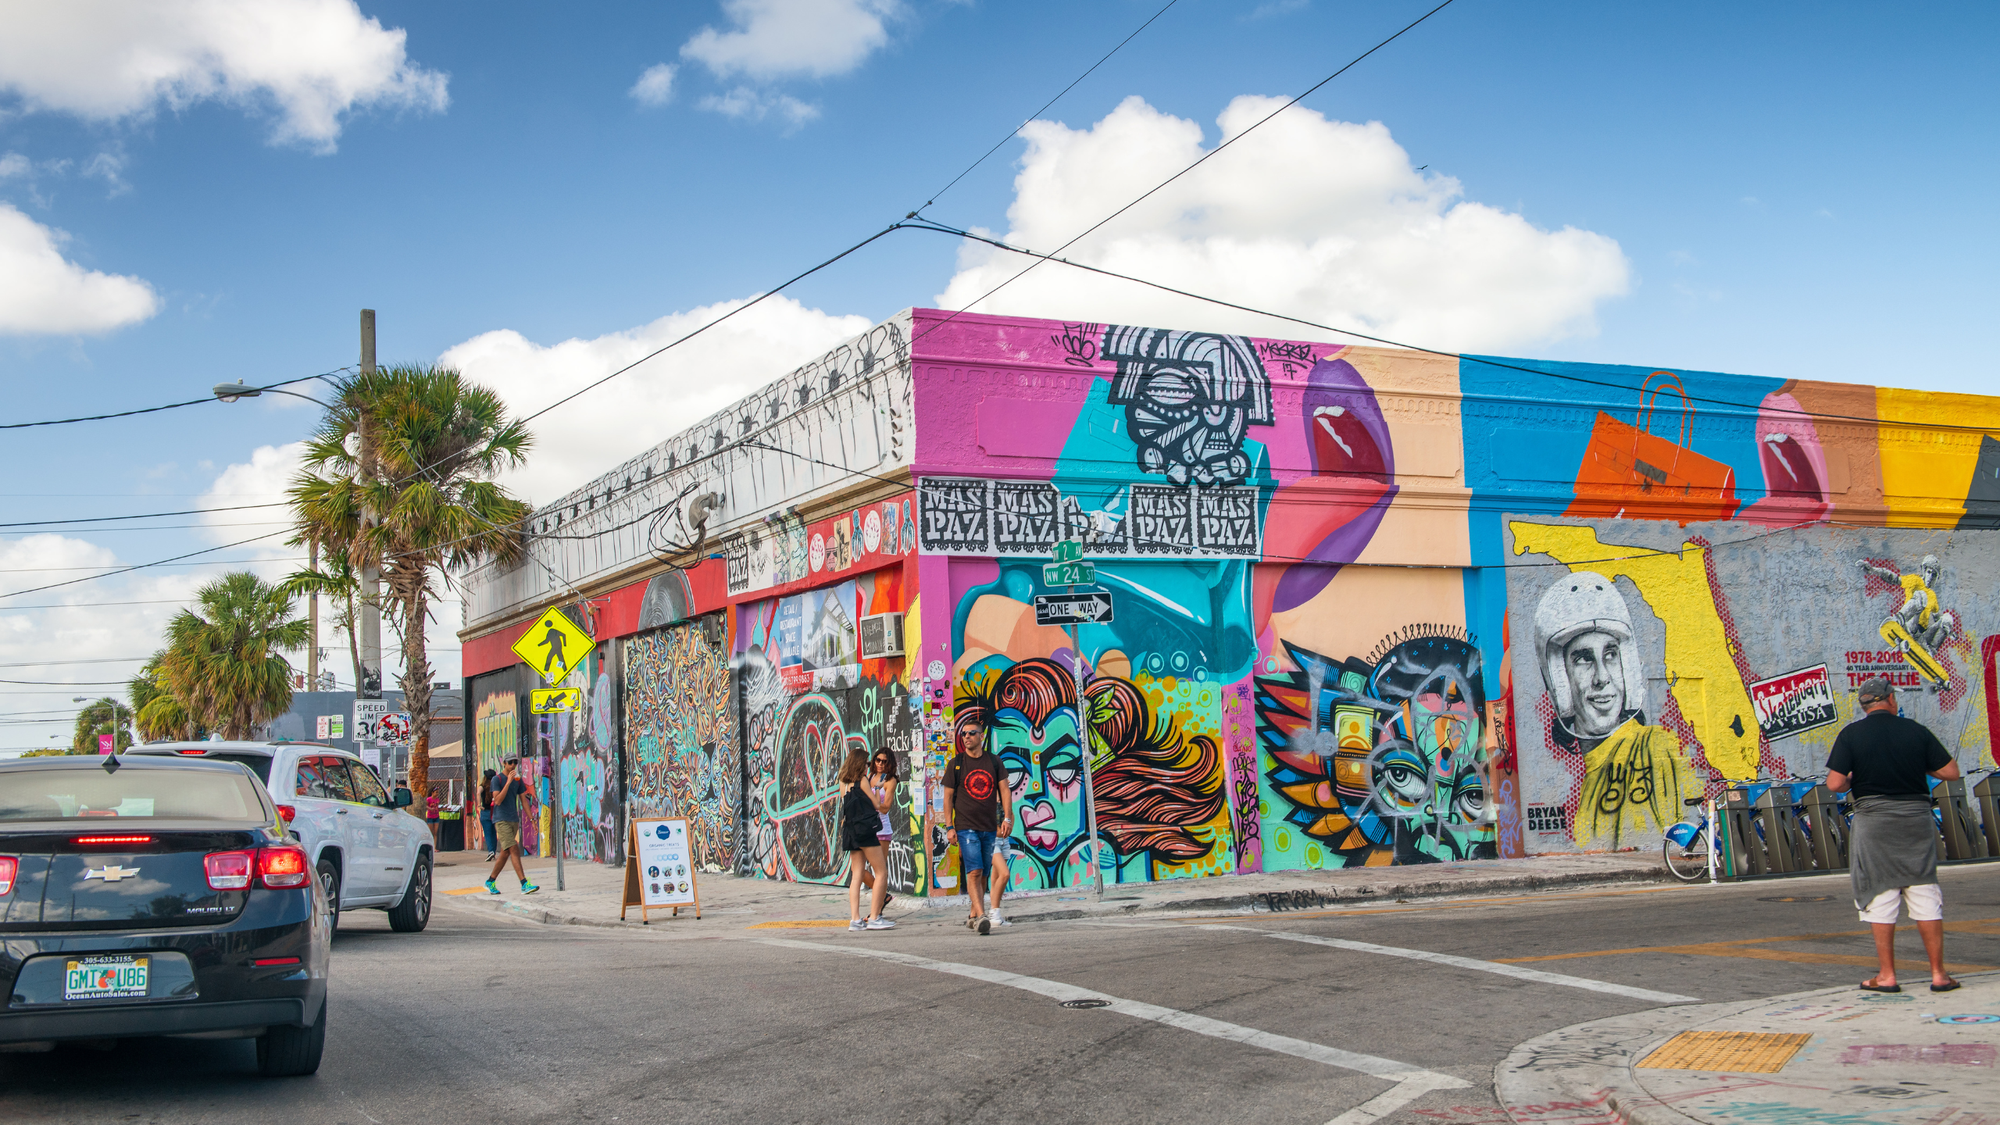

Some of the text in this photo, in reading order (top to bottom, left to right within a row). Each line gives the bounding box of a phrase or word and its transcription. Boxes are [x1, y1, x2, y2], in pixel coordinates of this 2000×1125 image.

[925, 487, 983, 511] MAS
[998, 490, 1054, 515] MAS
[1136, 494, 1187, 517] MAS
[1201, 495, 1250, 518] MAS
[925, 510, 985, 541] PAZ
[998, 514, 1055, 543] PAZ
[1136, 516, 1189, 545] PAZ
[1201, 517, 1253, 546] PAZ
[1063, 544, 1068, 560] 2
[729, 556, 748, 584] PAZ
[1046, 566, 1094, 583] NW 24 ST
[1050, 603, 1070, 616] ONE
[1078, 602, 1099, 614] WAY
[1844, 650, 1905, 664] 1978-2018
[357, 704, 386, 712] SPEED
[1798, 703, 1827, 724] USA
[1527, 806, 1566, 819] BRYAN
[1528, 818, 1567, 831] DEESE
[84, 955, 132, 964] 305-633-3155
[68, 967, 146, 990] GMI U86
[65, 990, 146, 1000] OceanAutoSales.com
